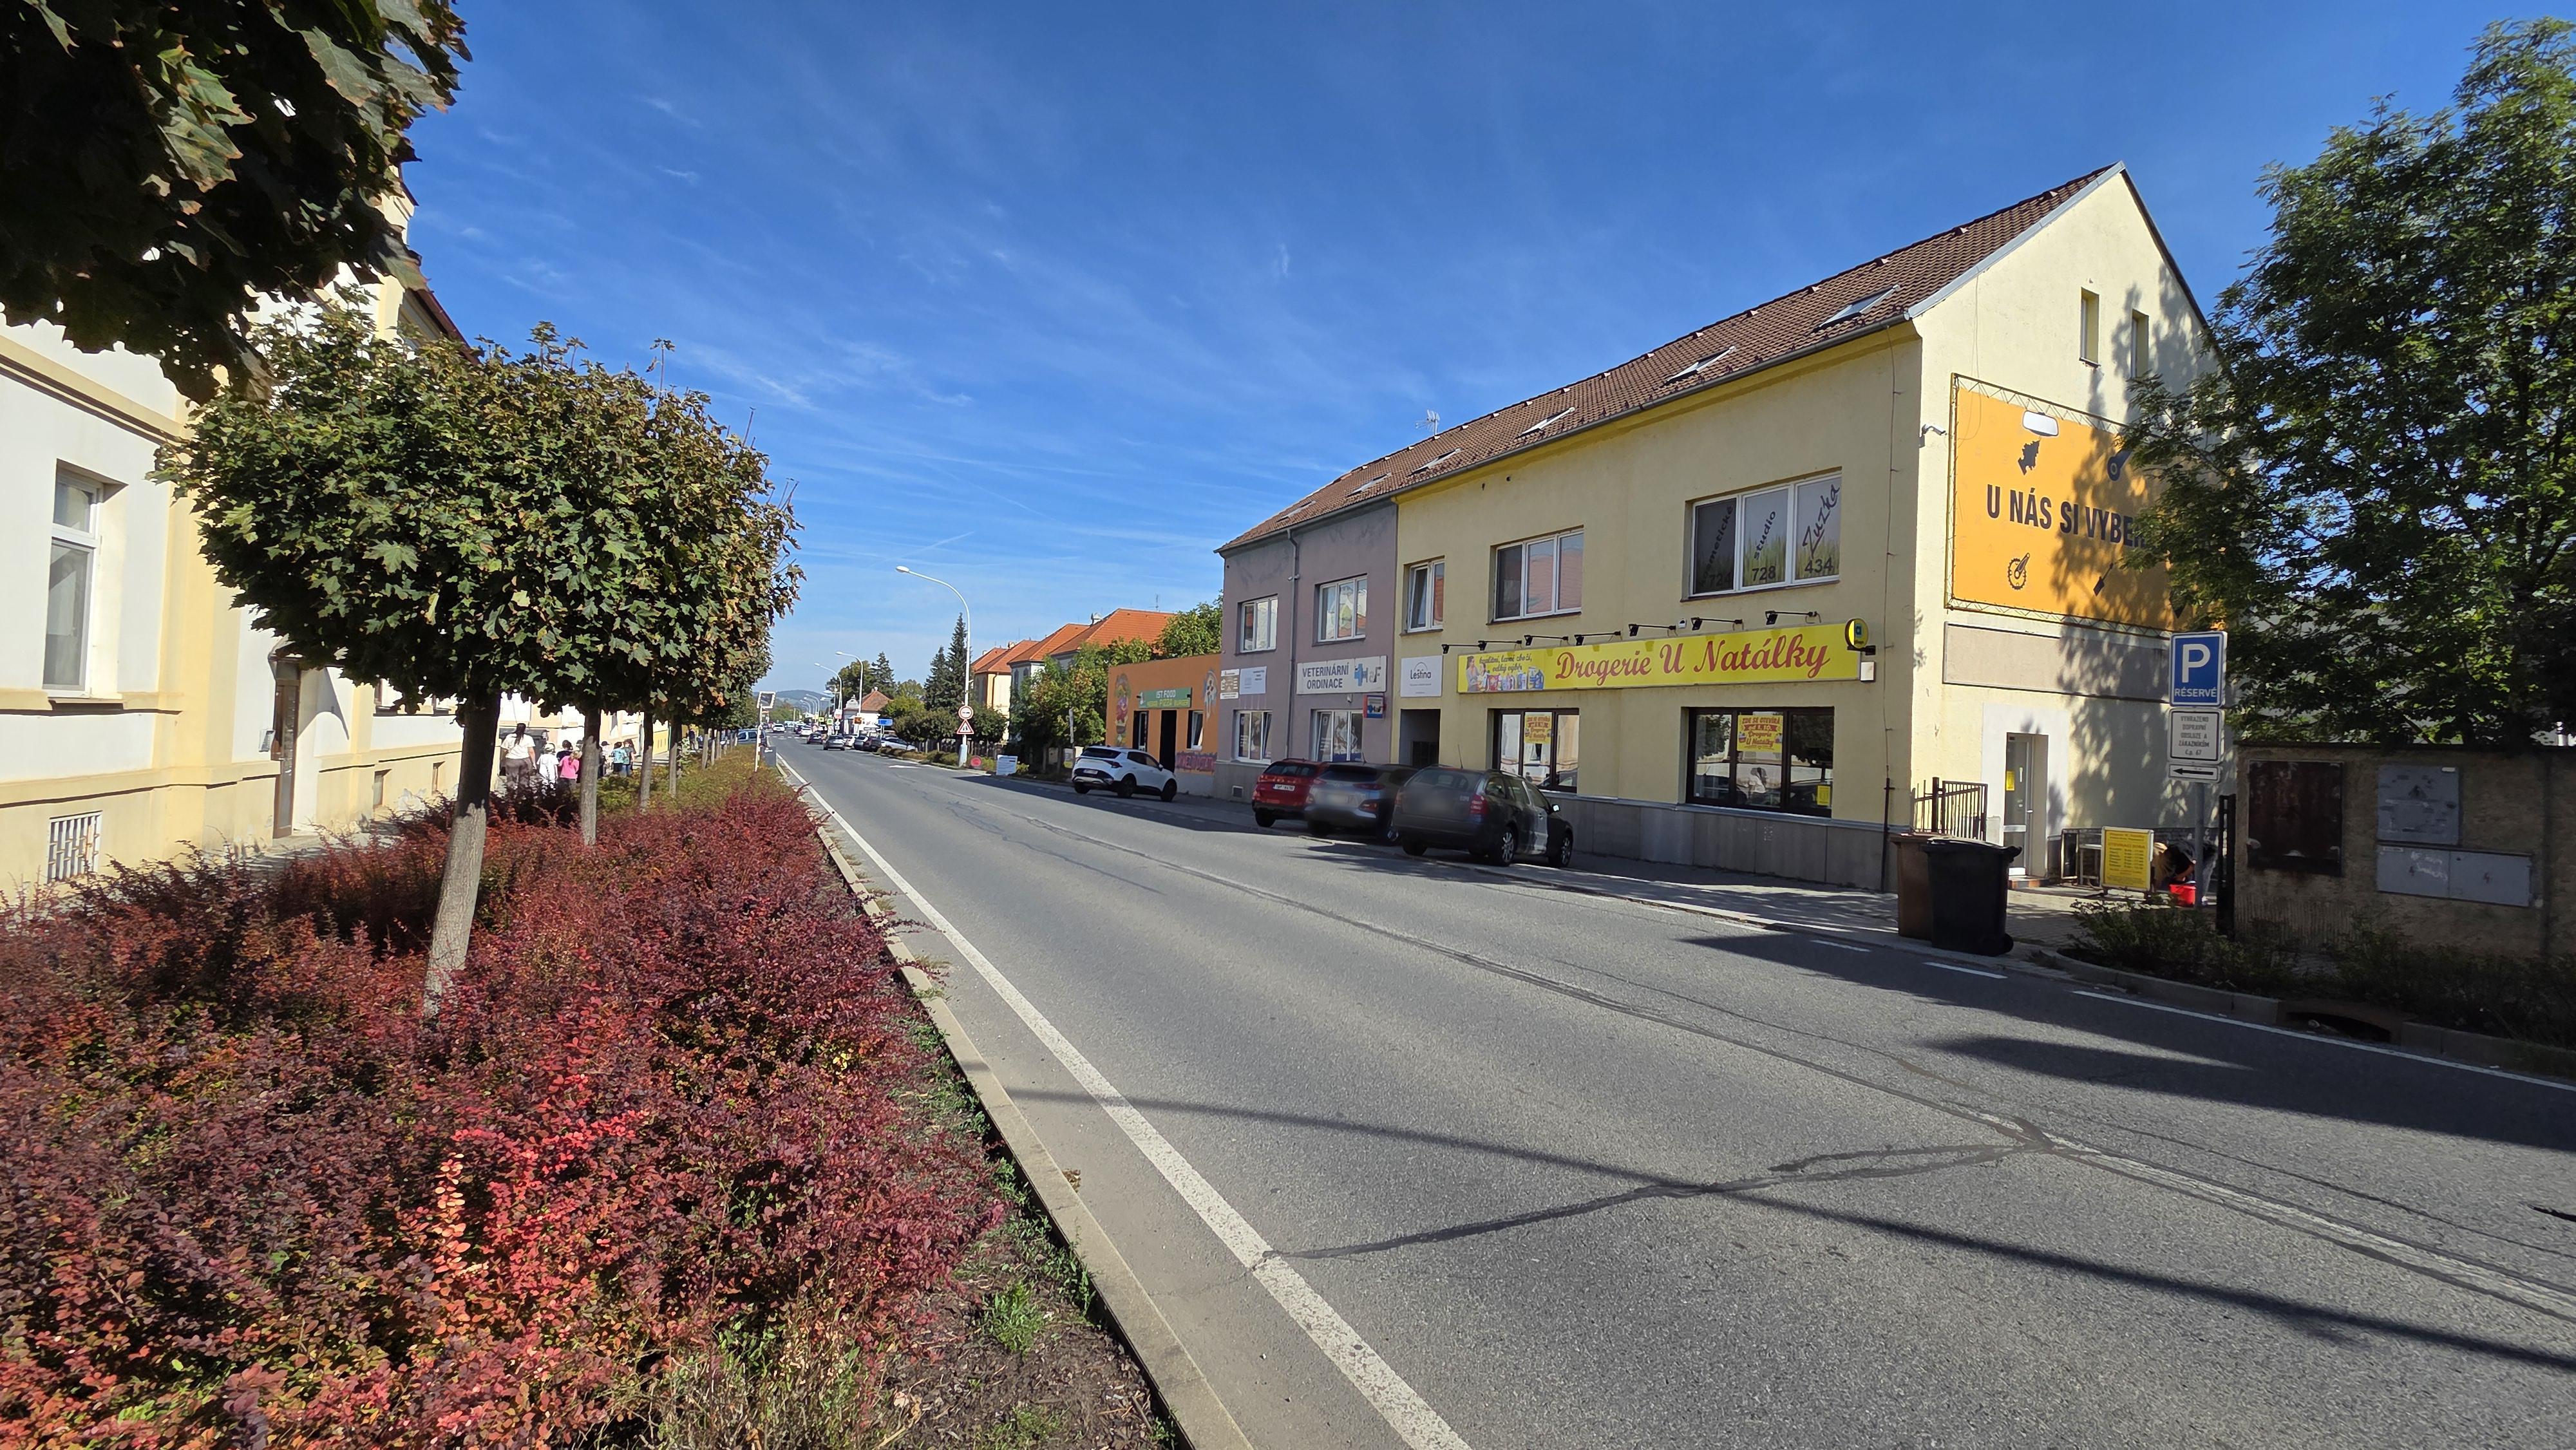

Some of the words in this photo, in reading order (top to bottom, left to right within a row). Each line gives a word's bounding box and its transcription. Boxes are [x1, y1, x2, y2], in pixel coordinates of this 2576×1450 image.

[1987, 484, 2000, 519] U
[2010, 487, 2052, 529] NÁS
[2060, 501, 2079, 534] SI
[1753, 511, 1776, 561] studio
[1752, 565, 1776, 581] 728
[1804, 557, 1834, 573] 434
[1555, 650, 1653, 686] Drogerie
[1660, 643, 1685, 674] U
[1694, 633, 1831, 679] Natálky
[2182, 643, 2211, 683] P
[1302, 662, 1350, 678] VETERINÁRNÍ
[1306, 678, 1343, 690] ORDINACE
[2174, 686, 2217, 697] RÉSERVÉ
